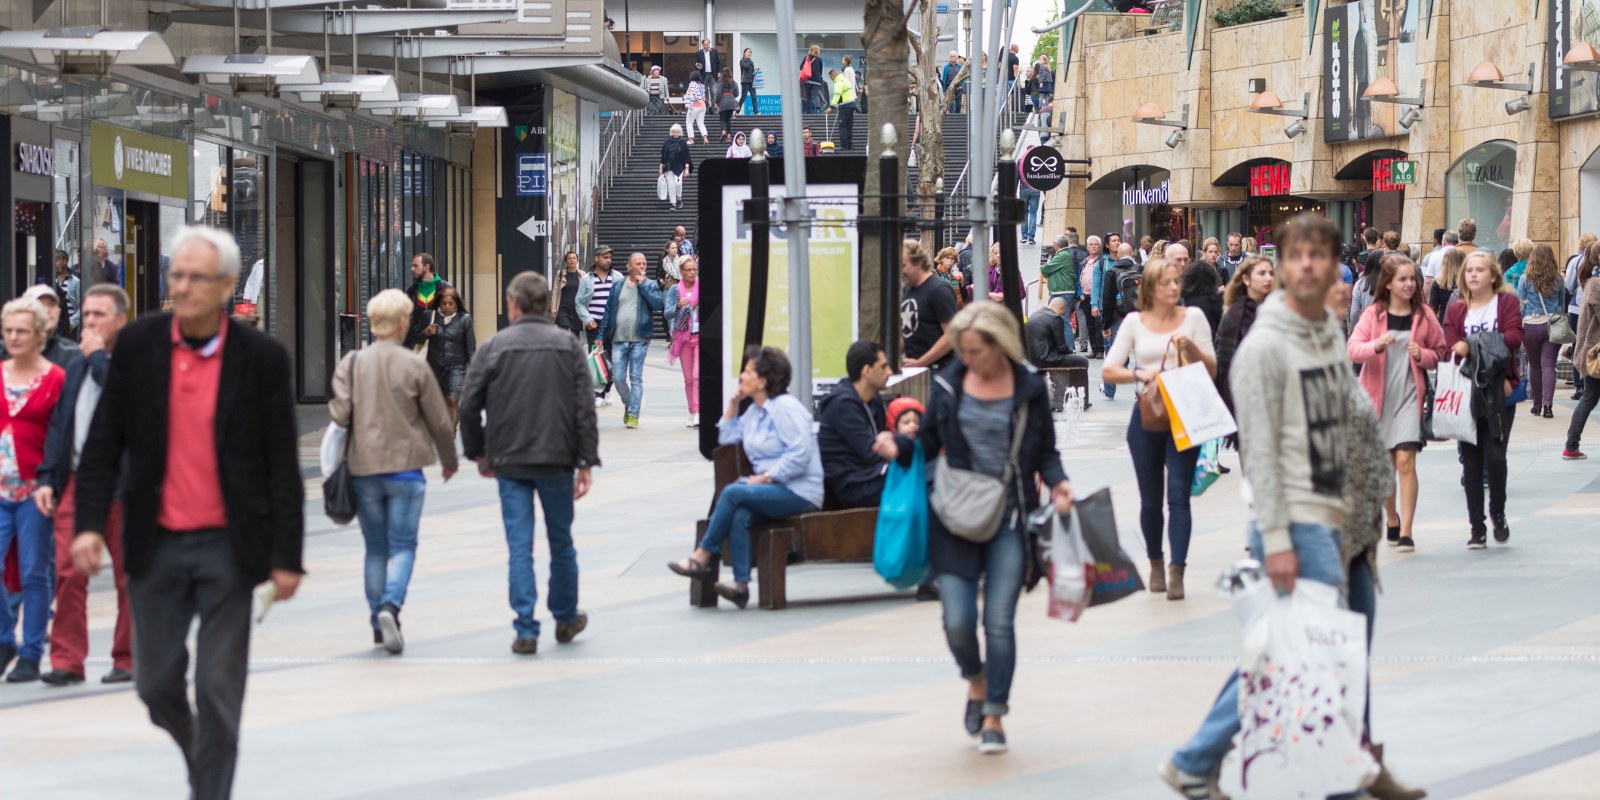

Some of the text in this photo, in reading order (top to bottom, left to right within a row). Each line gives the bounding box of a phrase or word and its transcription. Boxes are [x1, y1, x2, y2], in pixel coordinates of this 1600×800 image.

[125, 146, 172, 177] YVES ROCHER
[1476, 164, 1505, 183] ZARA
[1250, 163, 1291, 197] HEMA
